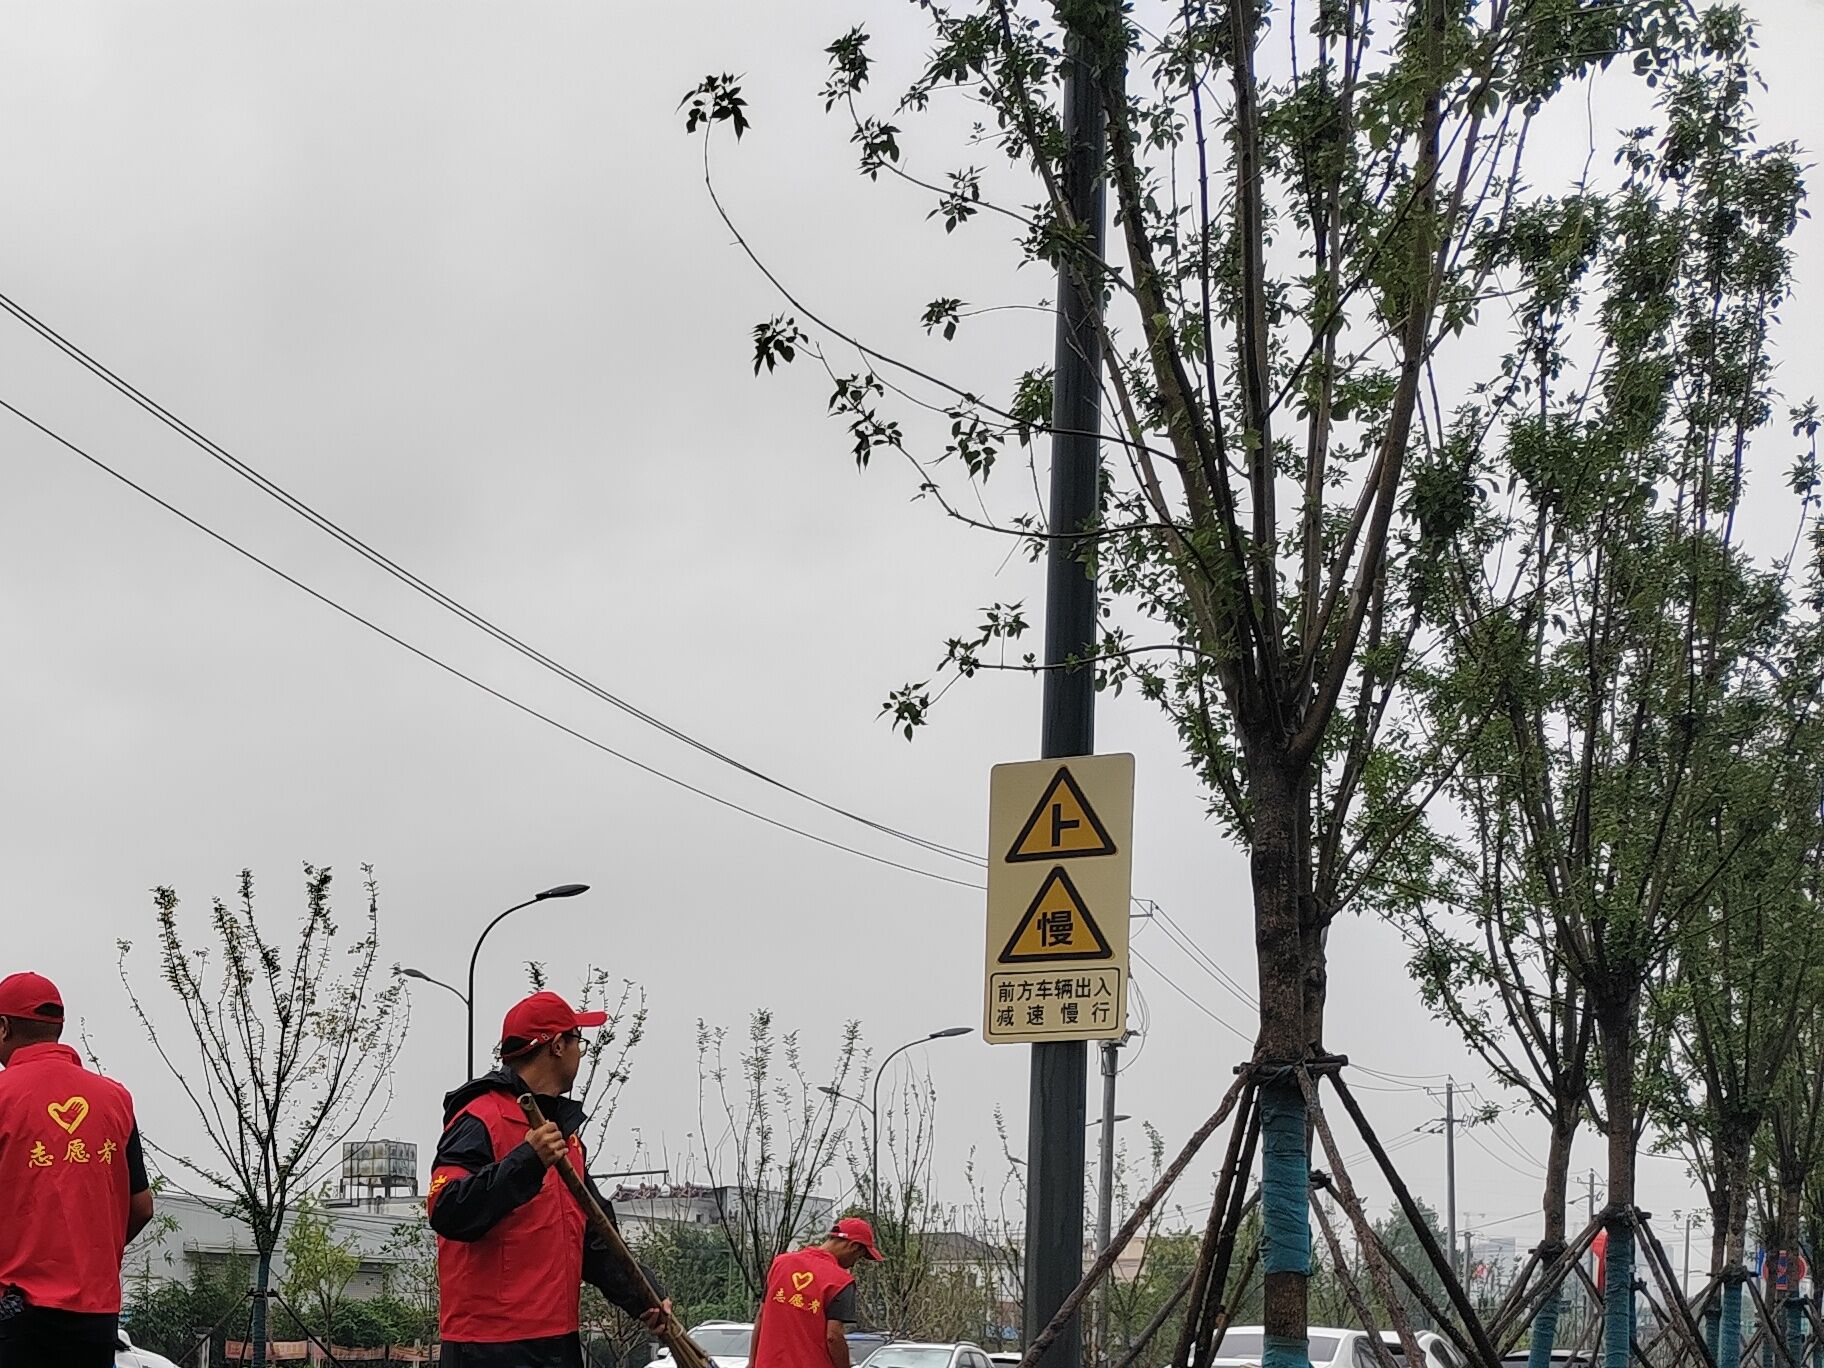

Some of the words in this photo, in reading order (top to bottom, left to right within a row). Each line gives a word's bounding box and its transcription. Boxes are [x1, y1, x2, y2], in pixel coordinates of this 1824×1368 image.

[1037, 910, 1074, 947] 慢
[997, 976, 1112, 1003] 前方车辆出入
[996, 1001, 1111, 1027] 减速慢行
[28, 1138, 118, 1169] 志愿者
[773, 1287, 821, 1314] 志愿者
